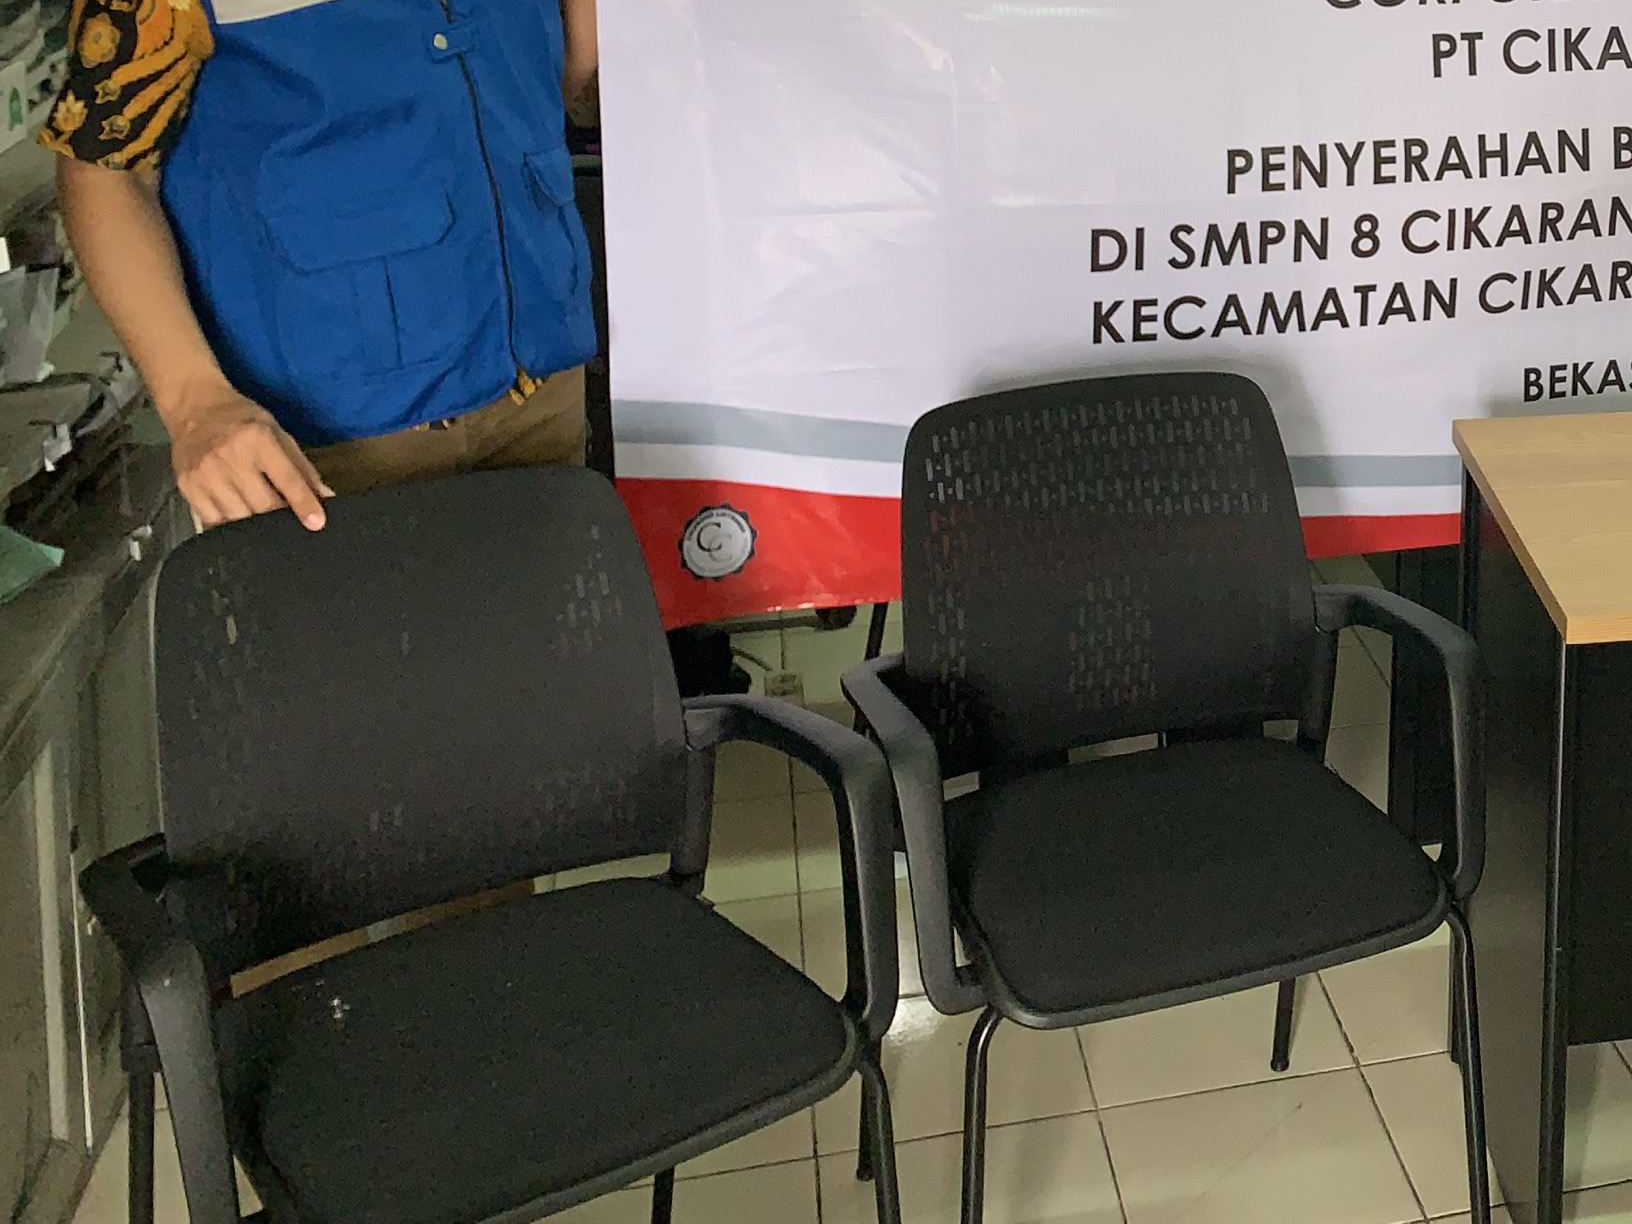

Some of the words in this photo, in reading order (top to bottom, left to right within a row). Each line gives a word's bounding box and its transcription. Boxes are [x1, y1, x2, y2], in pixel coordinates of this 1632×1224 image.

[1432, 31, 1484, 78] PT
[1226, 127, 1590, 195] PENYERAHAN
[1090, 227, 1145, 273] DI
[1167, 217, 1329, 270] SMPN
[1350, 213, 1380, 259] 8
[1092, 277, 1458, 345] KECAMATAN
